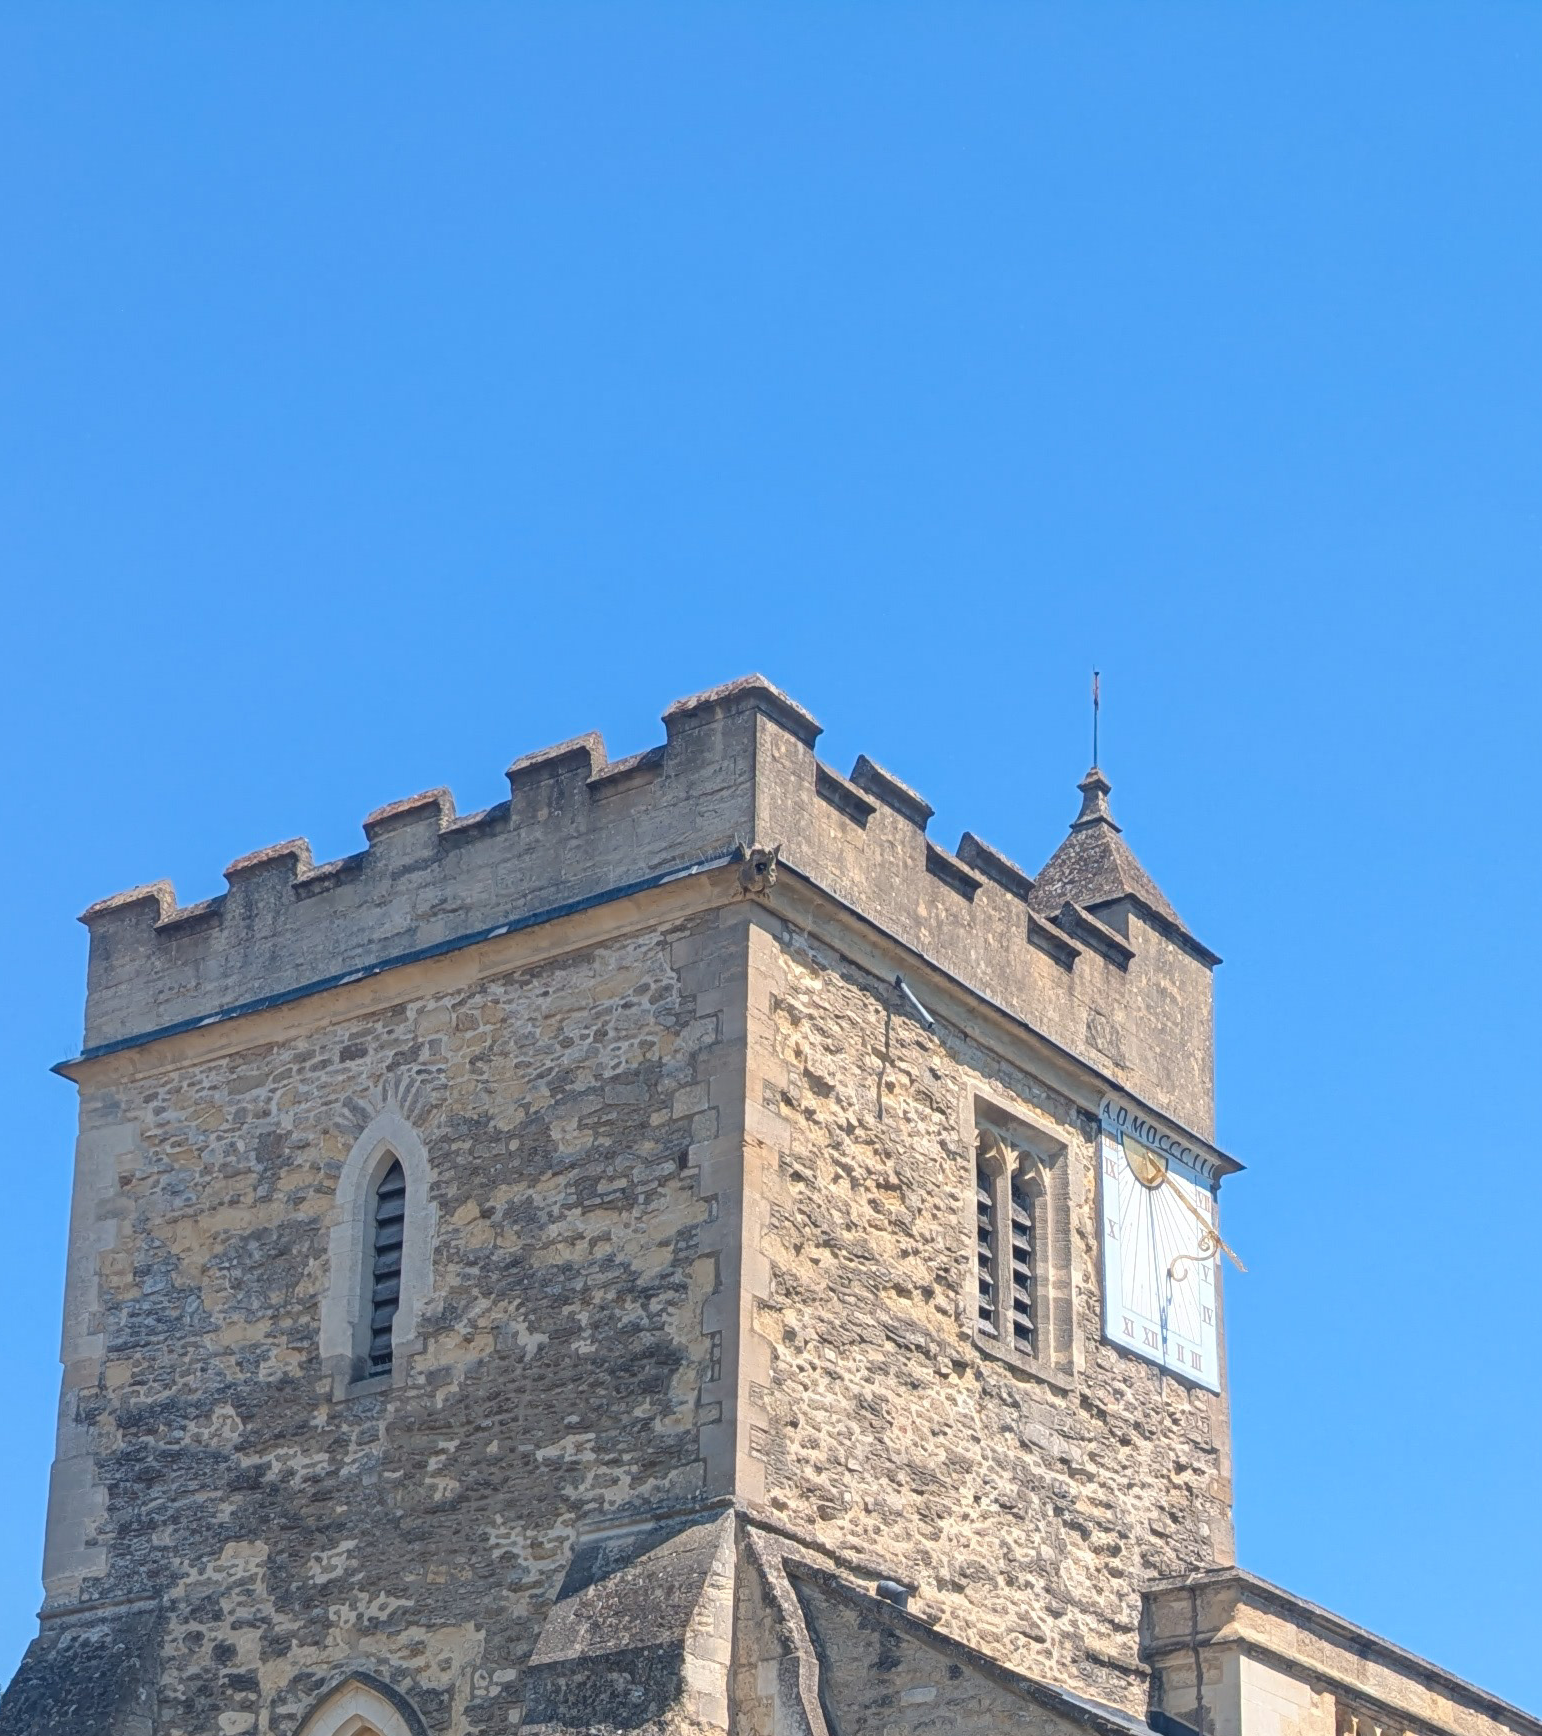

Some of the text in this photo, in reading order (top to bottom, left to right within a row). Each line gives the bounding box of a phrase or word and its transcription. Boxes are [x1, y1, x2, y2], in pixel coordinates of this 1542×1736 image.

[1104, 1156, 1118, 1181] IX
[1106, 1217, 1118, 1241] X
[1201, 1263, 1213, 1286] V
[1122, 1315, 1135, 1339] XI
[1201, 1304, 1214, 1327] IV
[1142, 1325, 1159, 1351] XII
[1176, 1343, 1186, 1364] II
[1190, 1350, 1203, 1373] III
